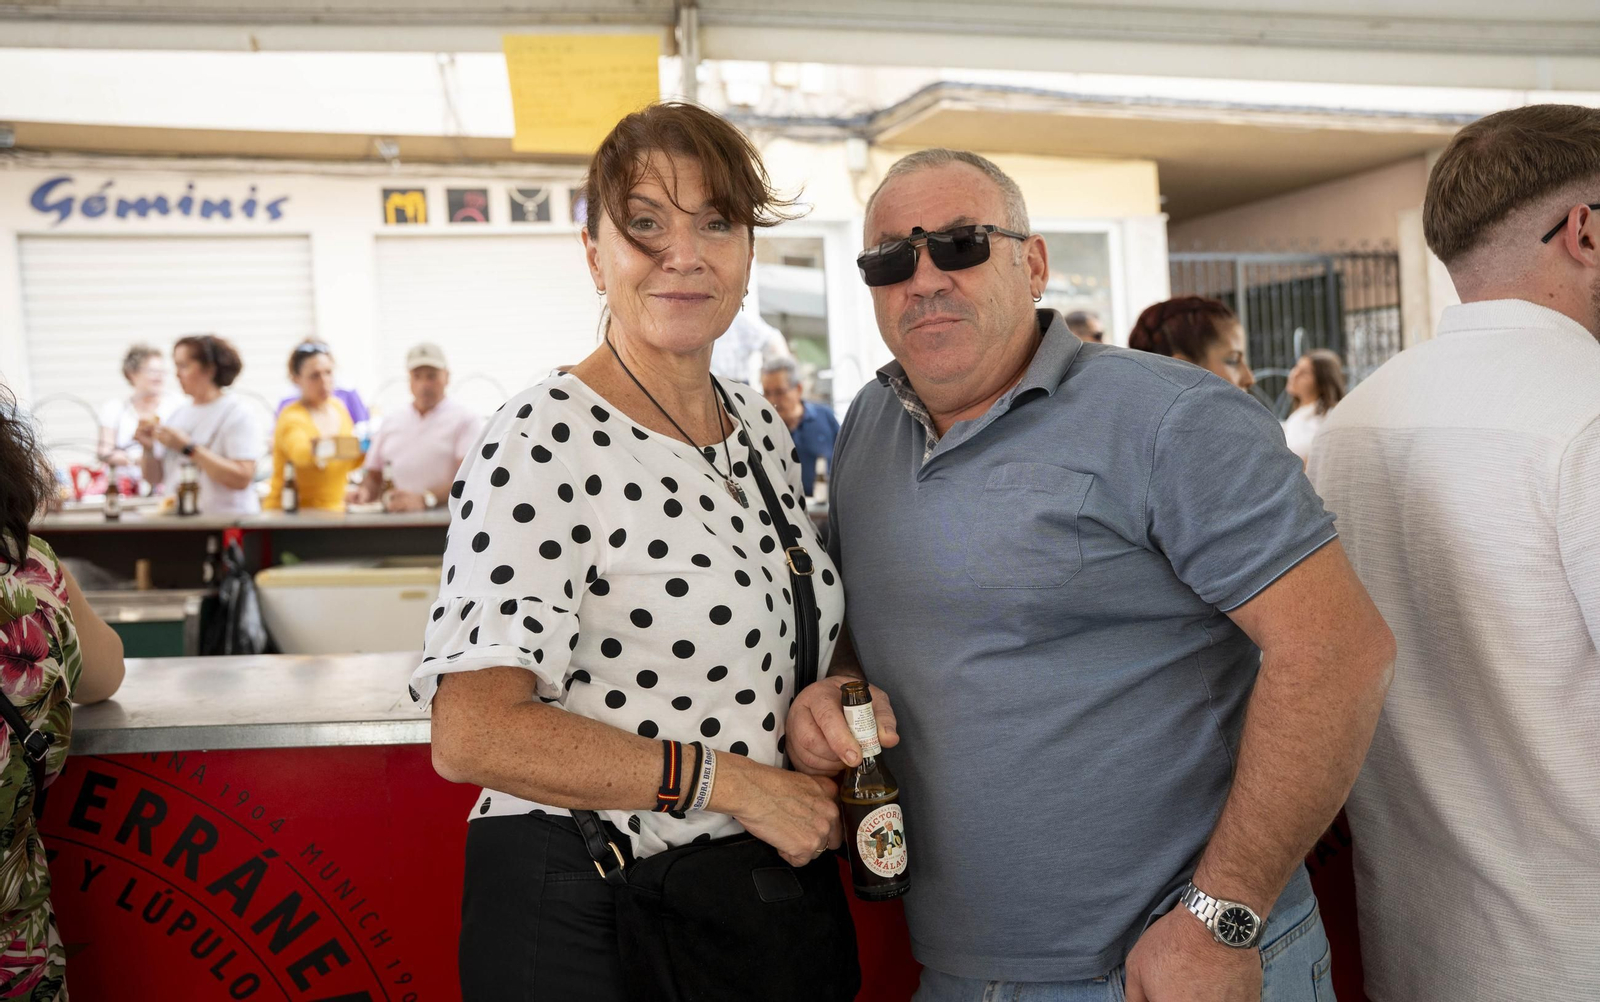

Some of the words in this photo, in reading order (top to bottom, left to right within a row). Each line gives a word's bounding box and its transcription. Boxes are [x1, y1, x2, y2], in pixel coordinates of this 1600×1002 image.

[30, 176, 290, 227] Géminis
[220, 783, 285, 834] 1904
[300, 842, 393, 948] MUNICH
[865, 811, 902, 833] VICTORIA
[873, 850, 906, 870] MÁLAGA
[33, 763, 373, 1002] ERRÁNE
[80, 858, 107, 892] Y
[116, 877, 260, 1000] LÚPULO
